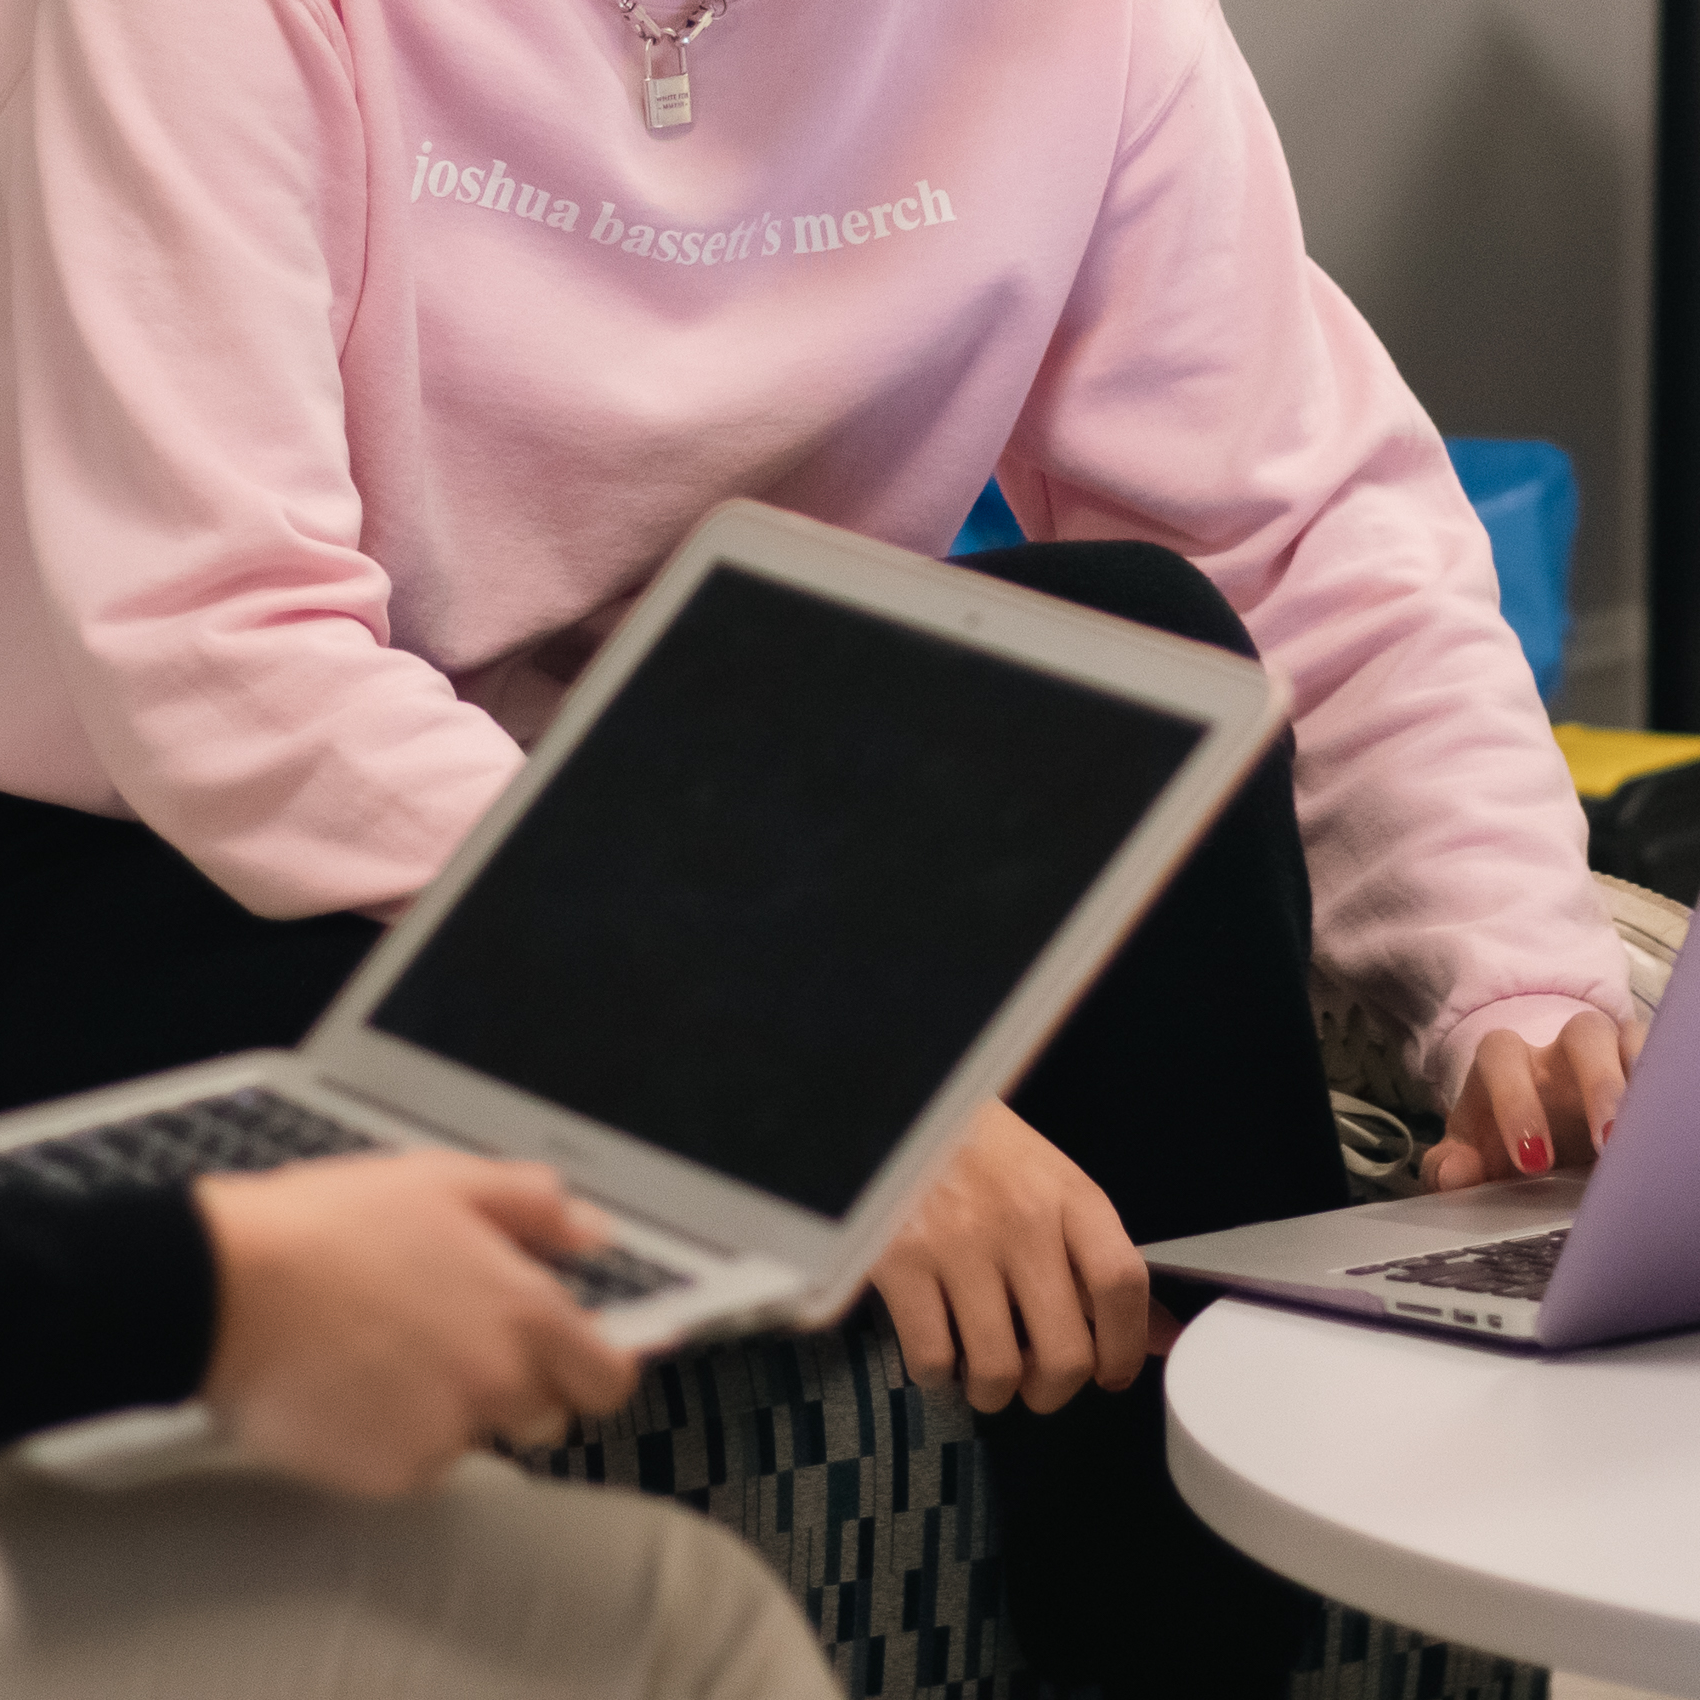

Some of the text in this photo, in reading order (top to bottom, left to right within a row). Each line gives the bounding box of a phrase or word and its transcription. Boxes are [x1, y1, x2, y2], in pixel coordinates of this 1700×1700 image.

[410, 141, 957, 267] joshua bassett's merch
